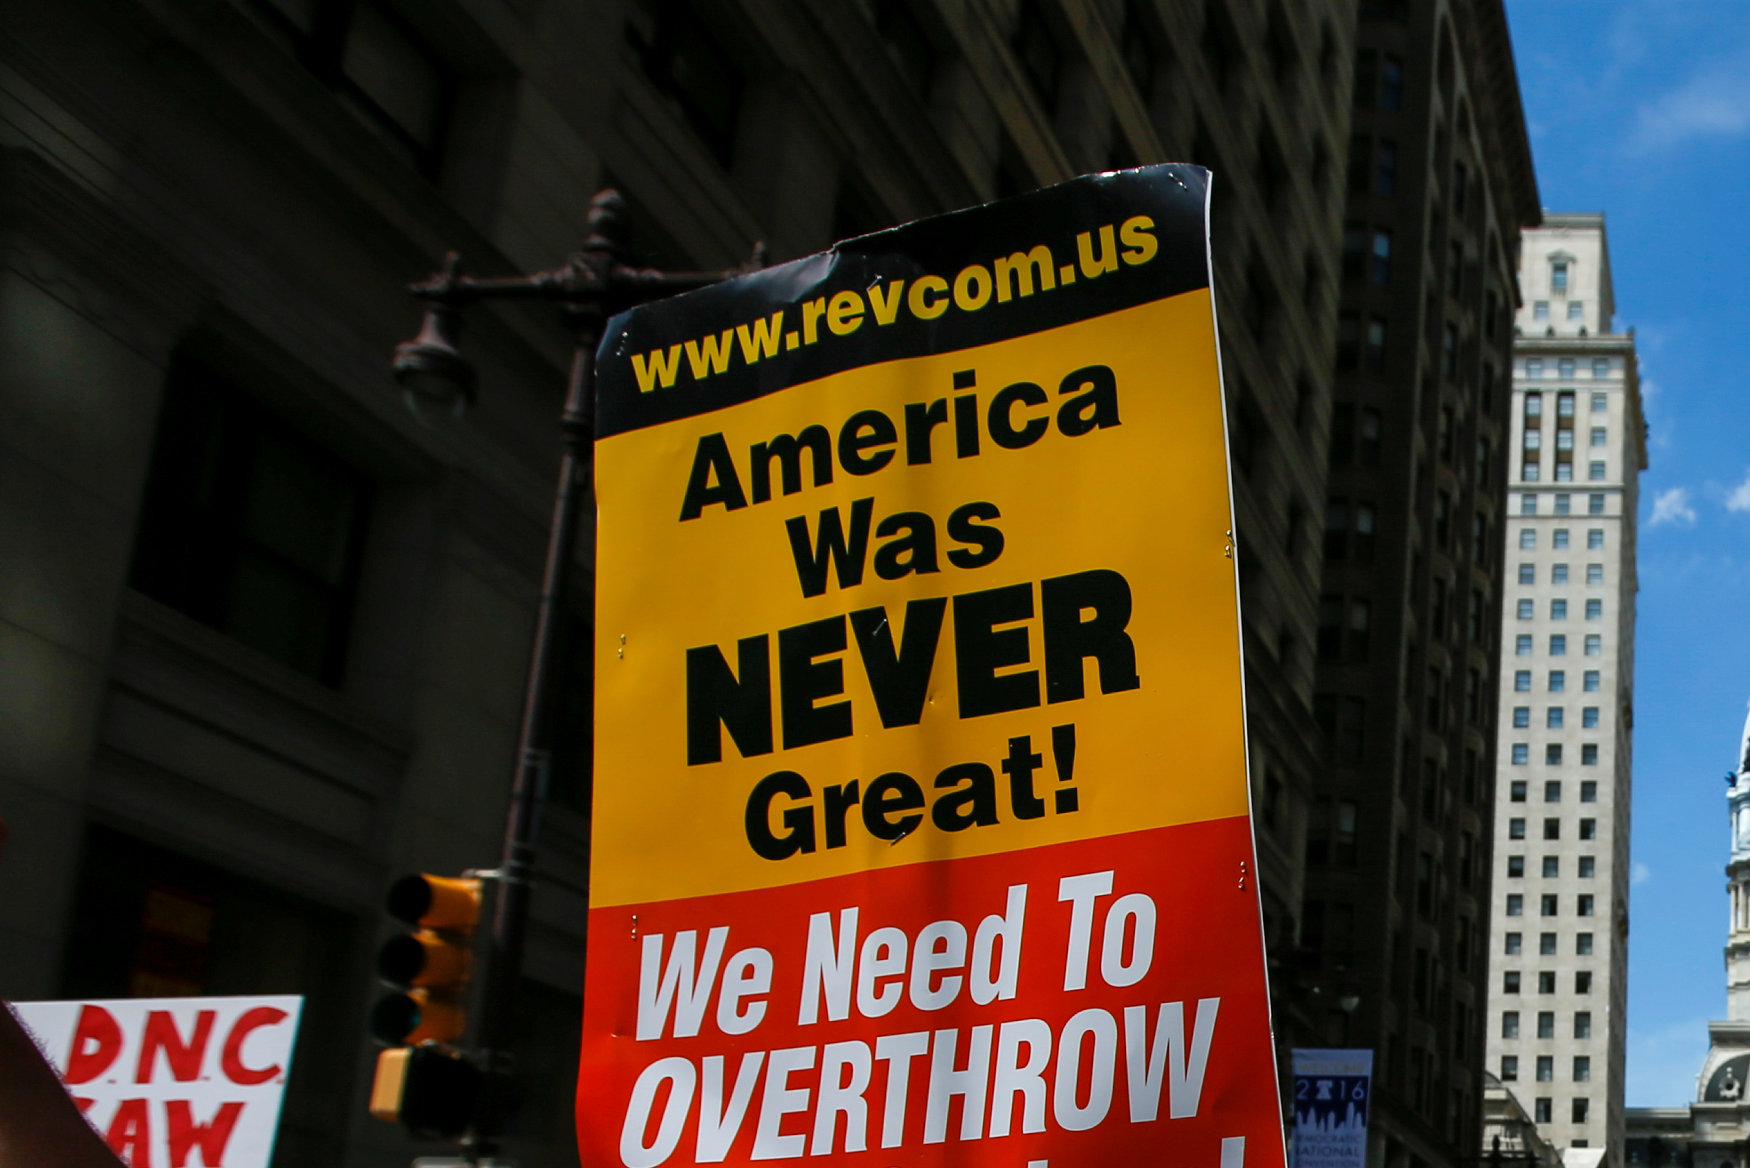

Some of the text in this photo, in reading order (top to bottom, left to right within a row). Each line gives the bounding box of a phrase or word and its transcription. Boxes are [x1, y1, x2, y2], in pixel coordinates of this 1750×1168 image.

[631, 214, 1160, 394] www.revcom.us
[678, 364, 1123, 523] America
[784, 496, 1006, 600] Was
[685, 568, 1141, 768] NEVER
[744, 722, 1081, 861] Great!
[635, 870, 1157, 1042] We Need To
